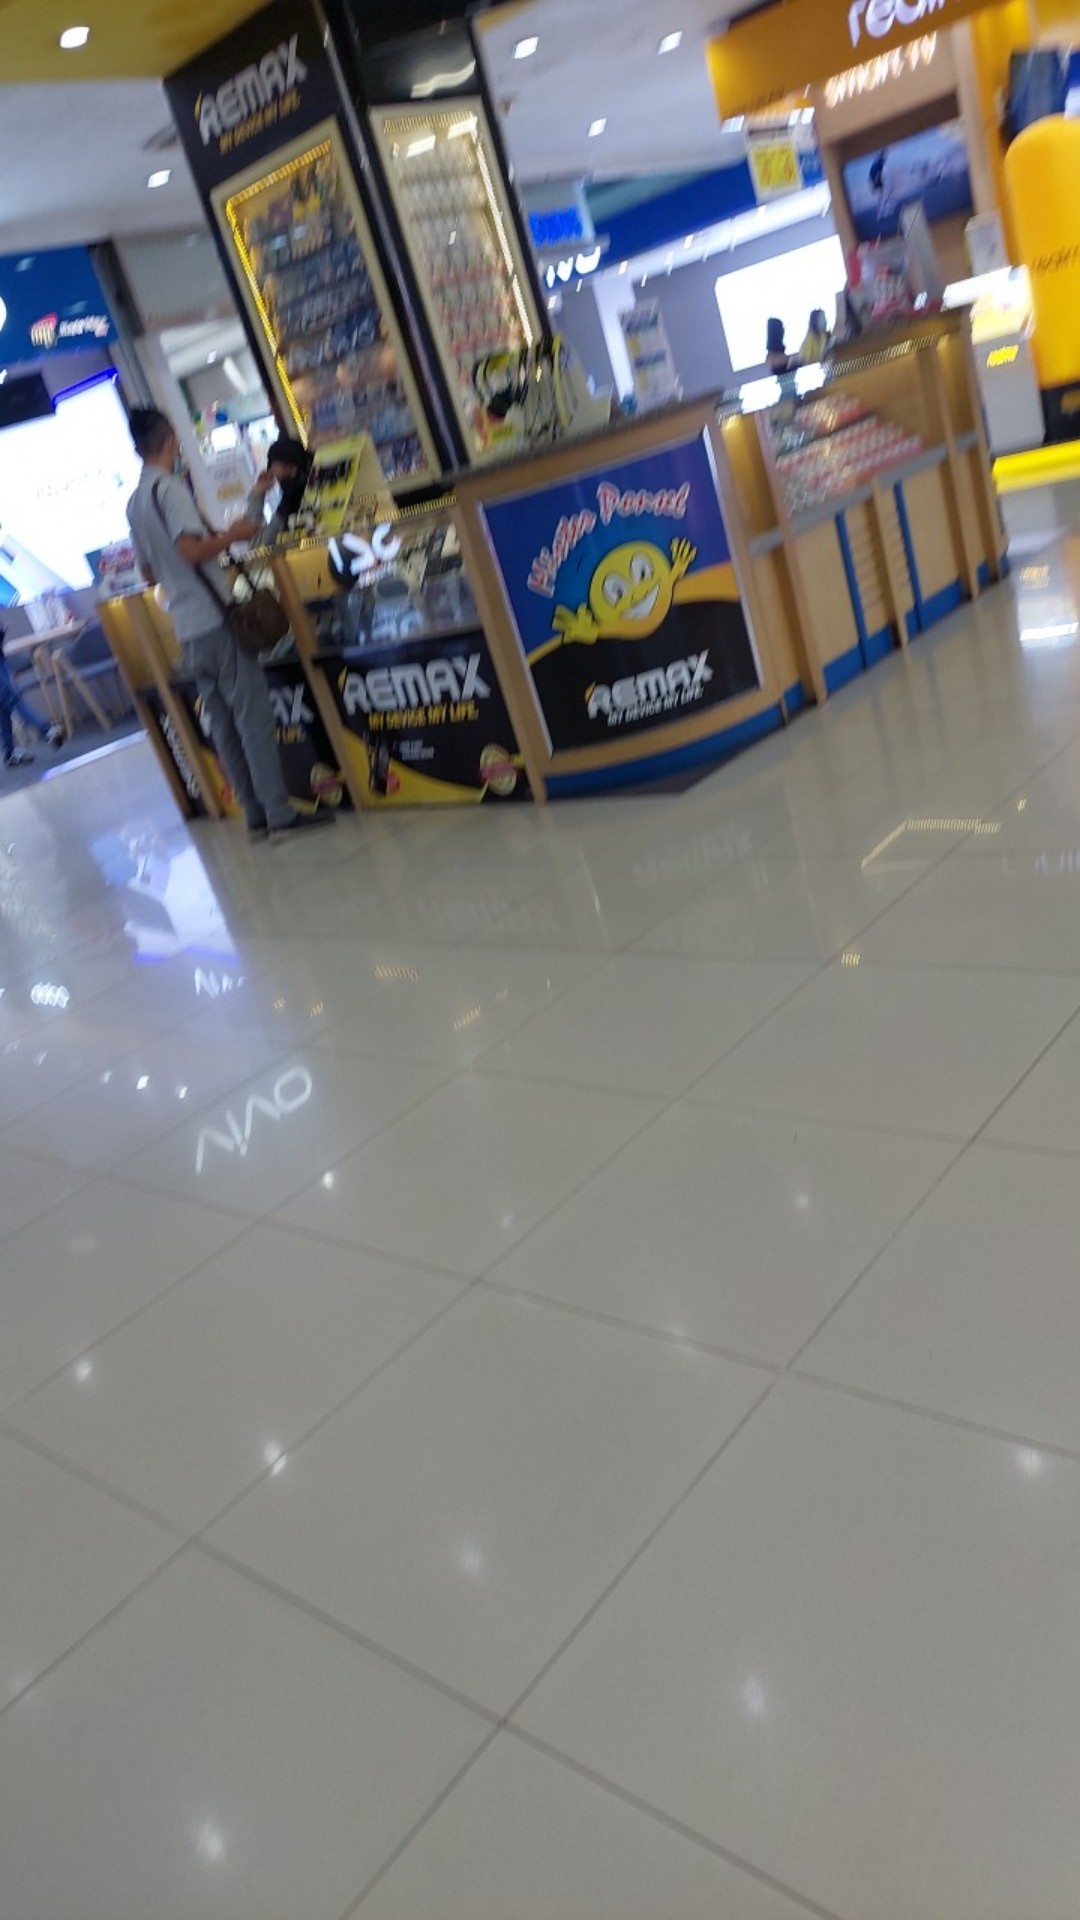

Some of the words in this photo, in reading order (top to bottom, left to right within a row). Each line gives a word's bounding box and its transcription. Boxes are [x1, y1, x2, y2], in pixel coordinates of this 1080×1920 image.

[195, 33, 308, 147] REMAX
[338, 653, 491, 716] REMAX
[585, 648, 714, 719] REMAX
